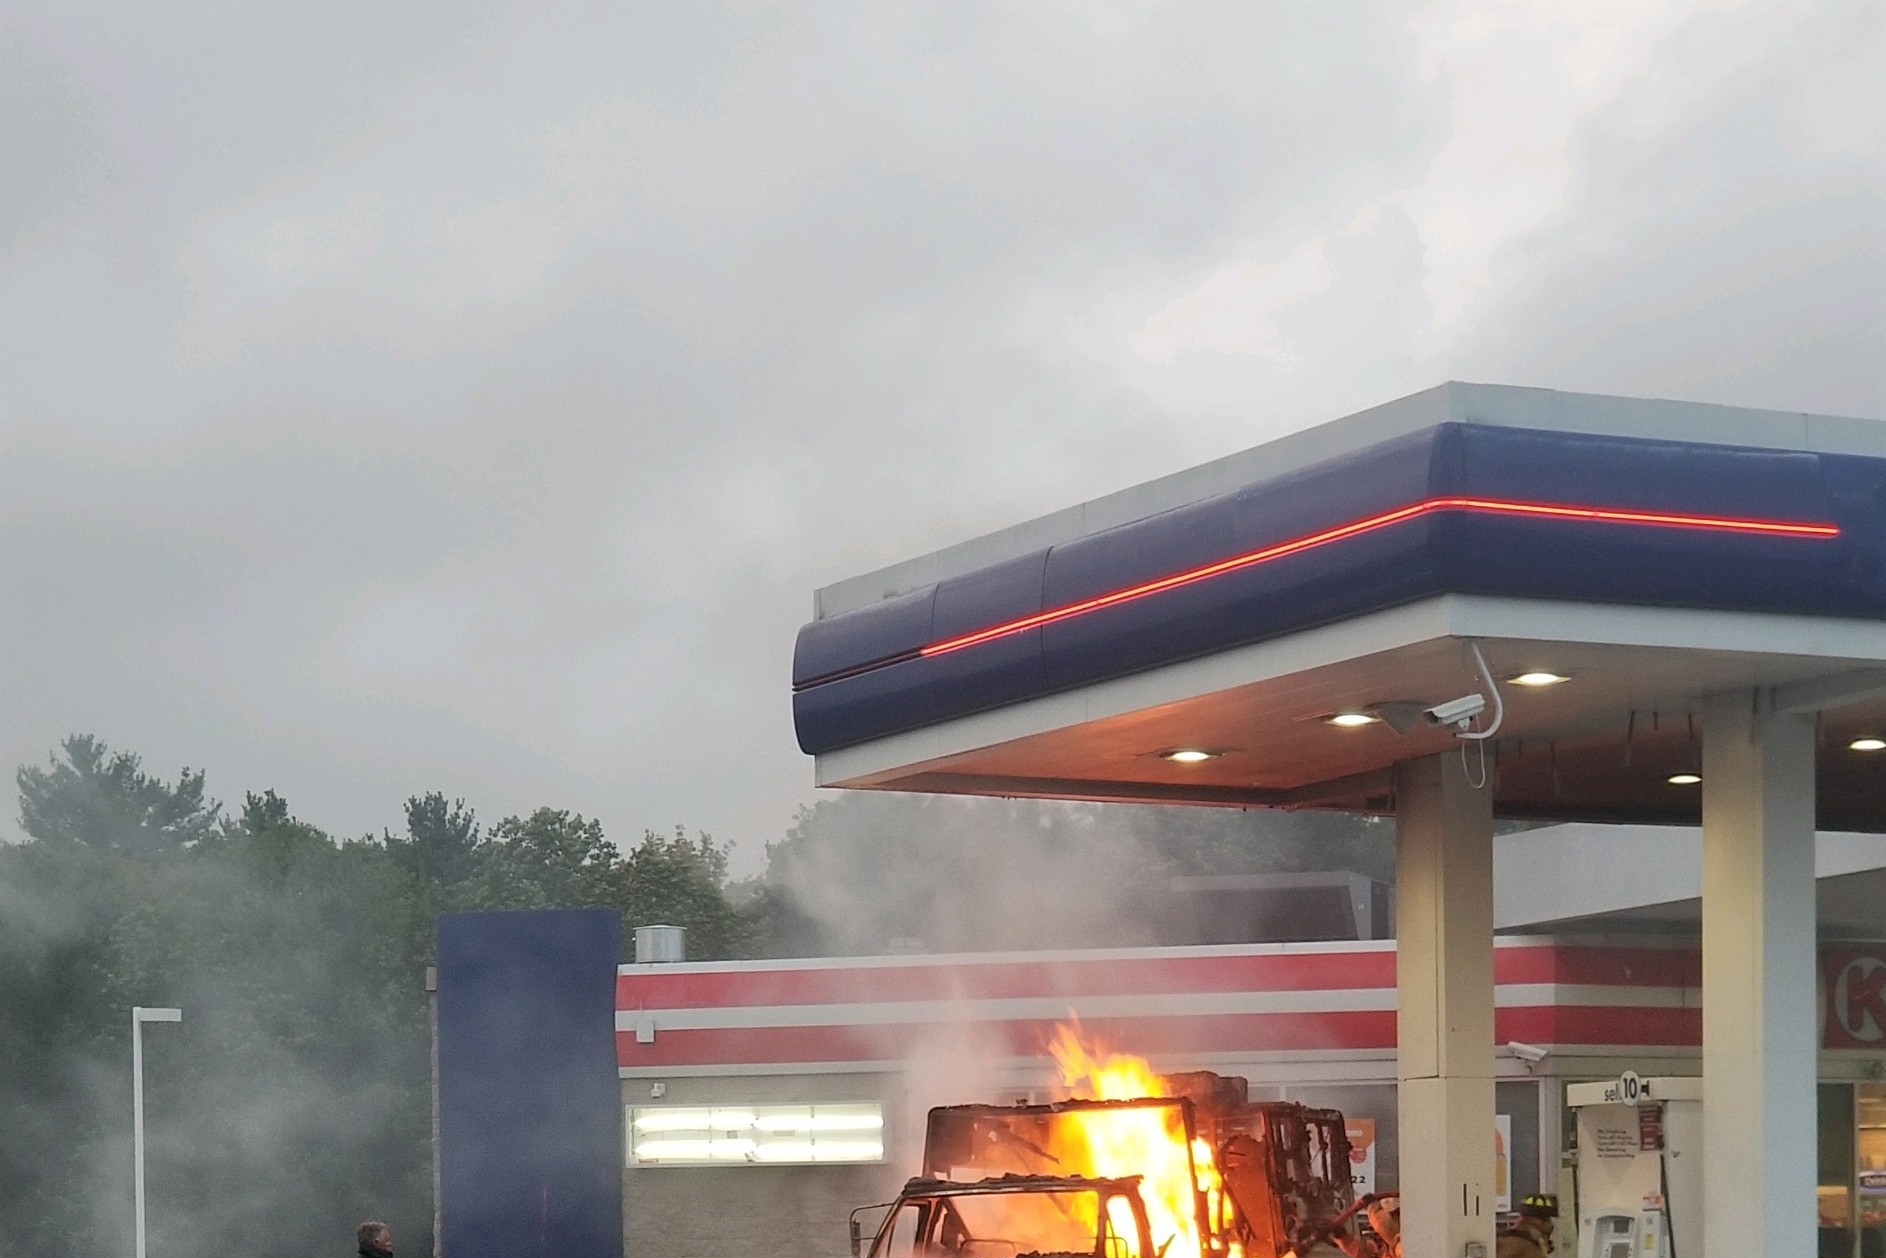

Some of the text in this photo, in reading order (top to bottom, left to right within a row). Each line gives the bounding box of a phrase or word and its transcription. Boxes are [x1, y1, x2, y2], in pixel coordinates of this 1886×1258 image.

[1847, 965, 1886, 1033] K
[1604, 1083, 1619, 1102] sel
[1623, 1077, 1638, 1099] 10
